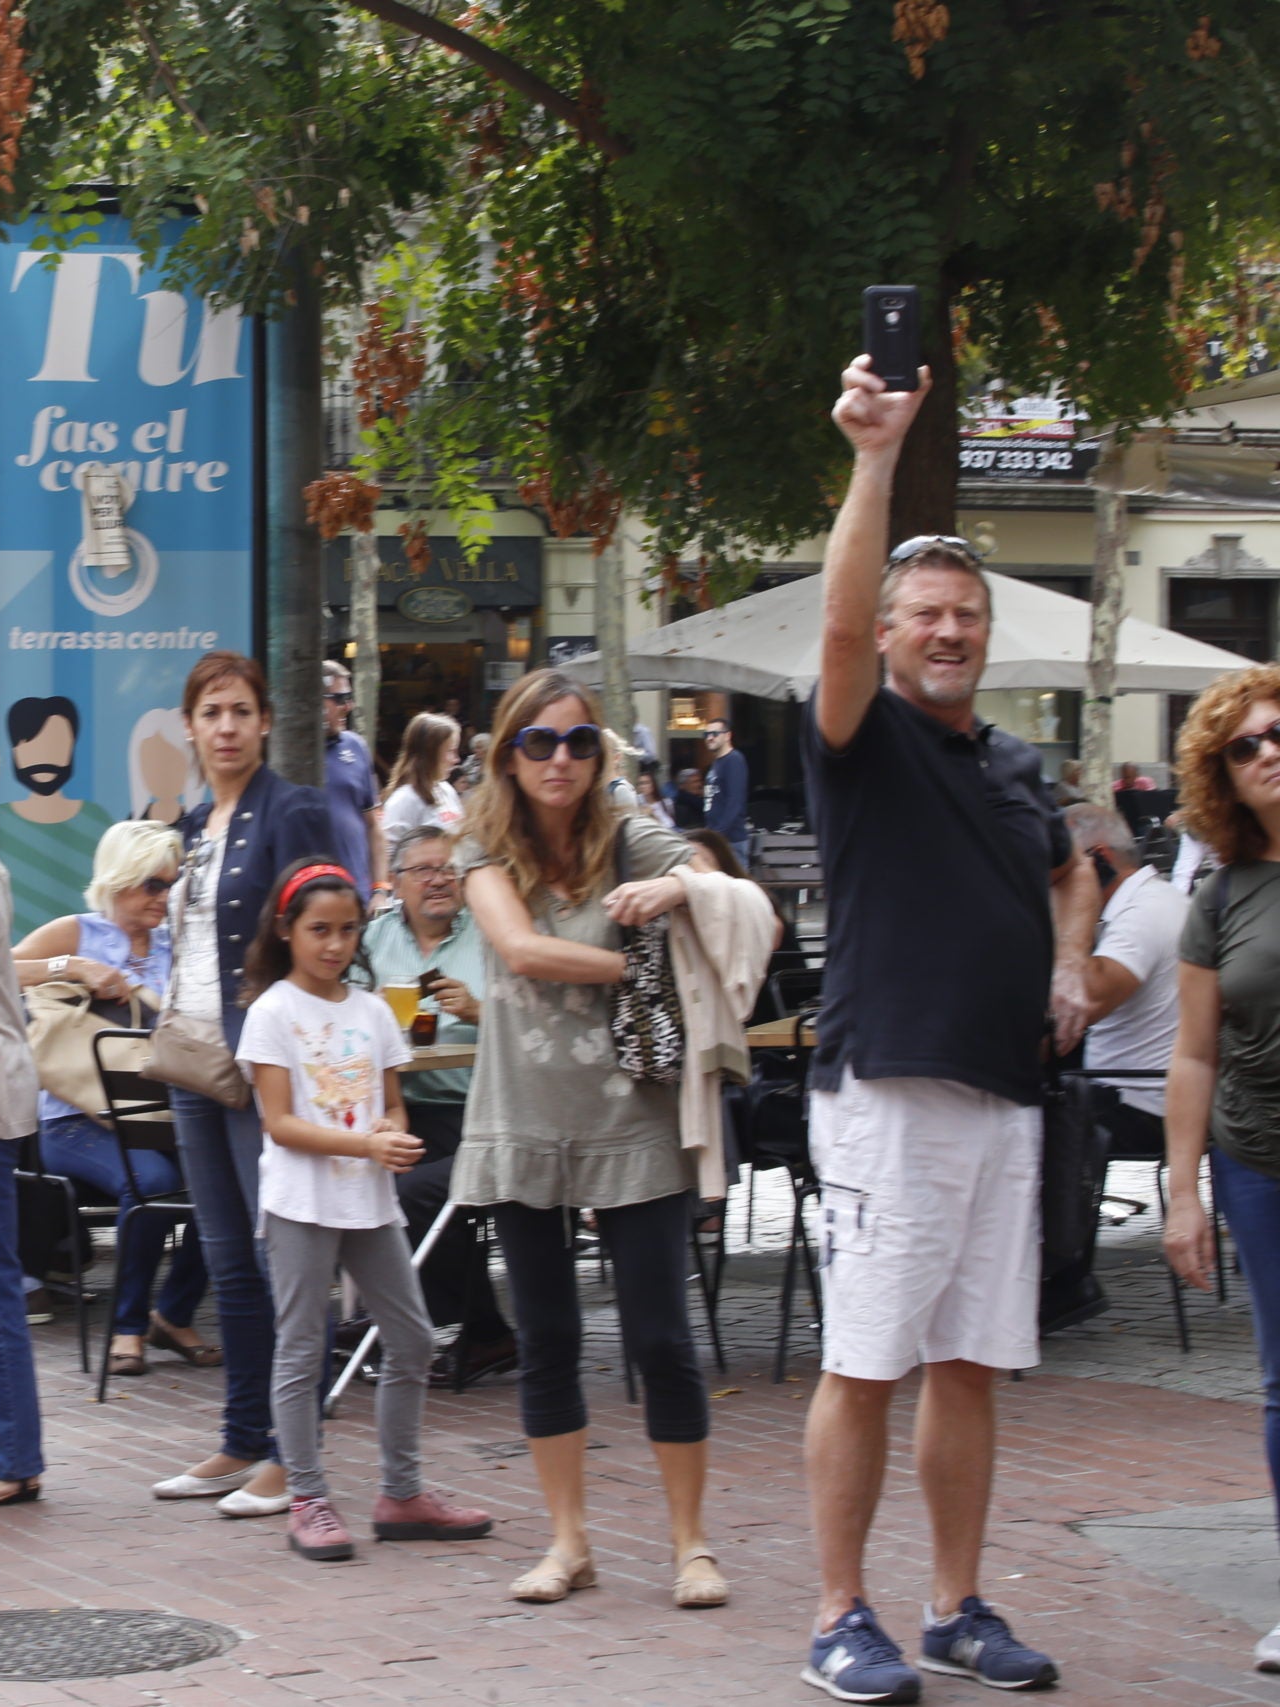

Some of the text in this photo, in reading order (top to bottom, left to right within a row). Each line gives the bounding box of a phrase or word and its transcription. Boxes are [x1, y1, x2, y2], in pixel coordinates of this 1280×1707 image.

[9, 251, 246, 387] Tu
[14, 405, 188, 467] fas el
[958, 450, 1073, 470] 937 333 342
[8, 626, 218, 650] terrassacentre
